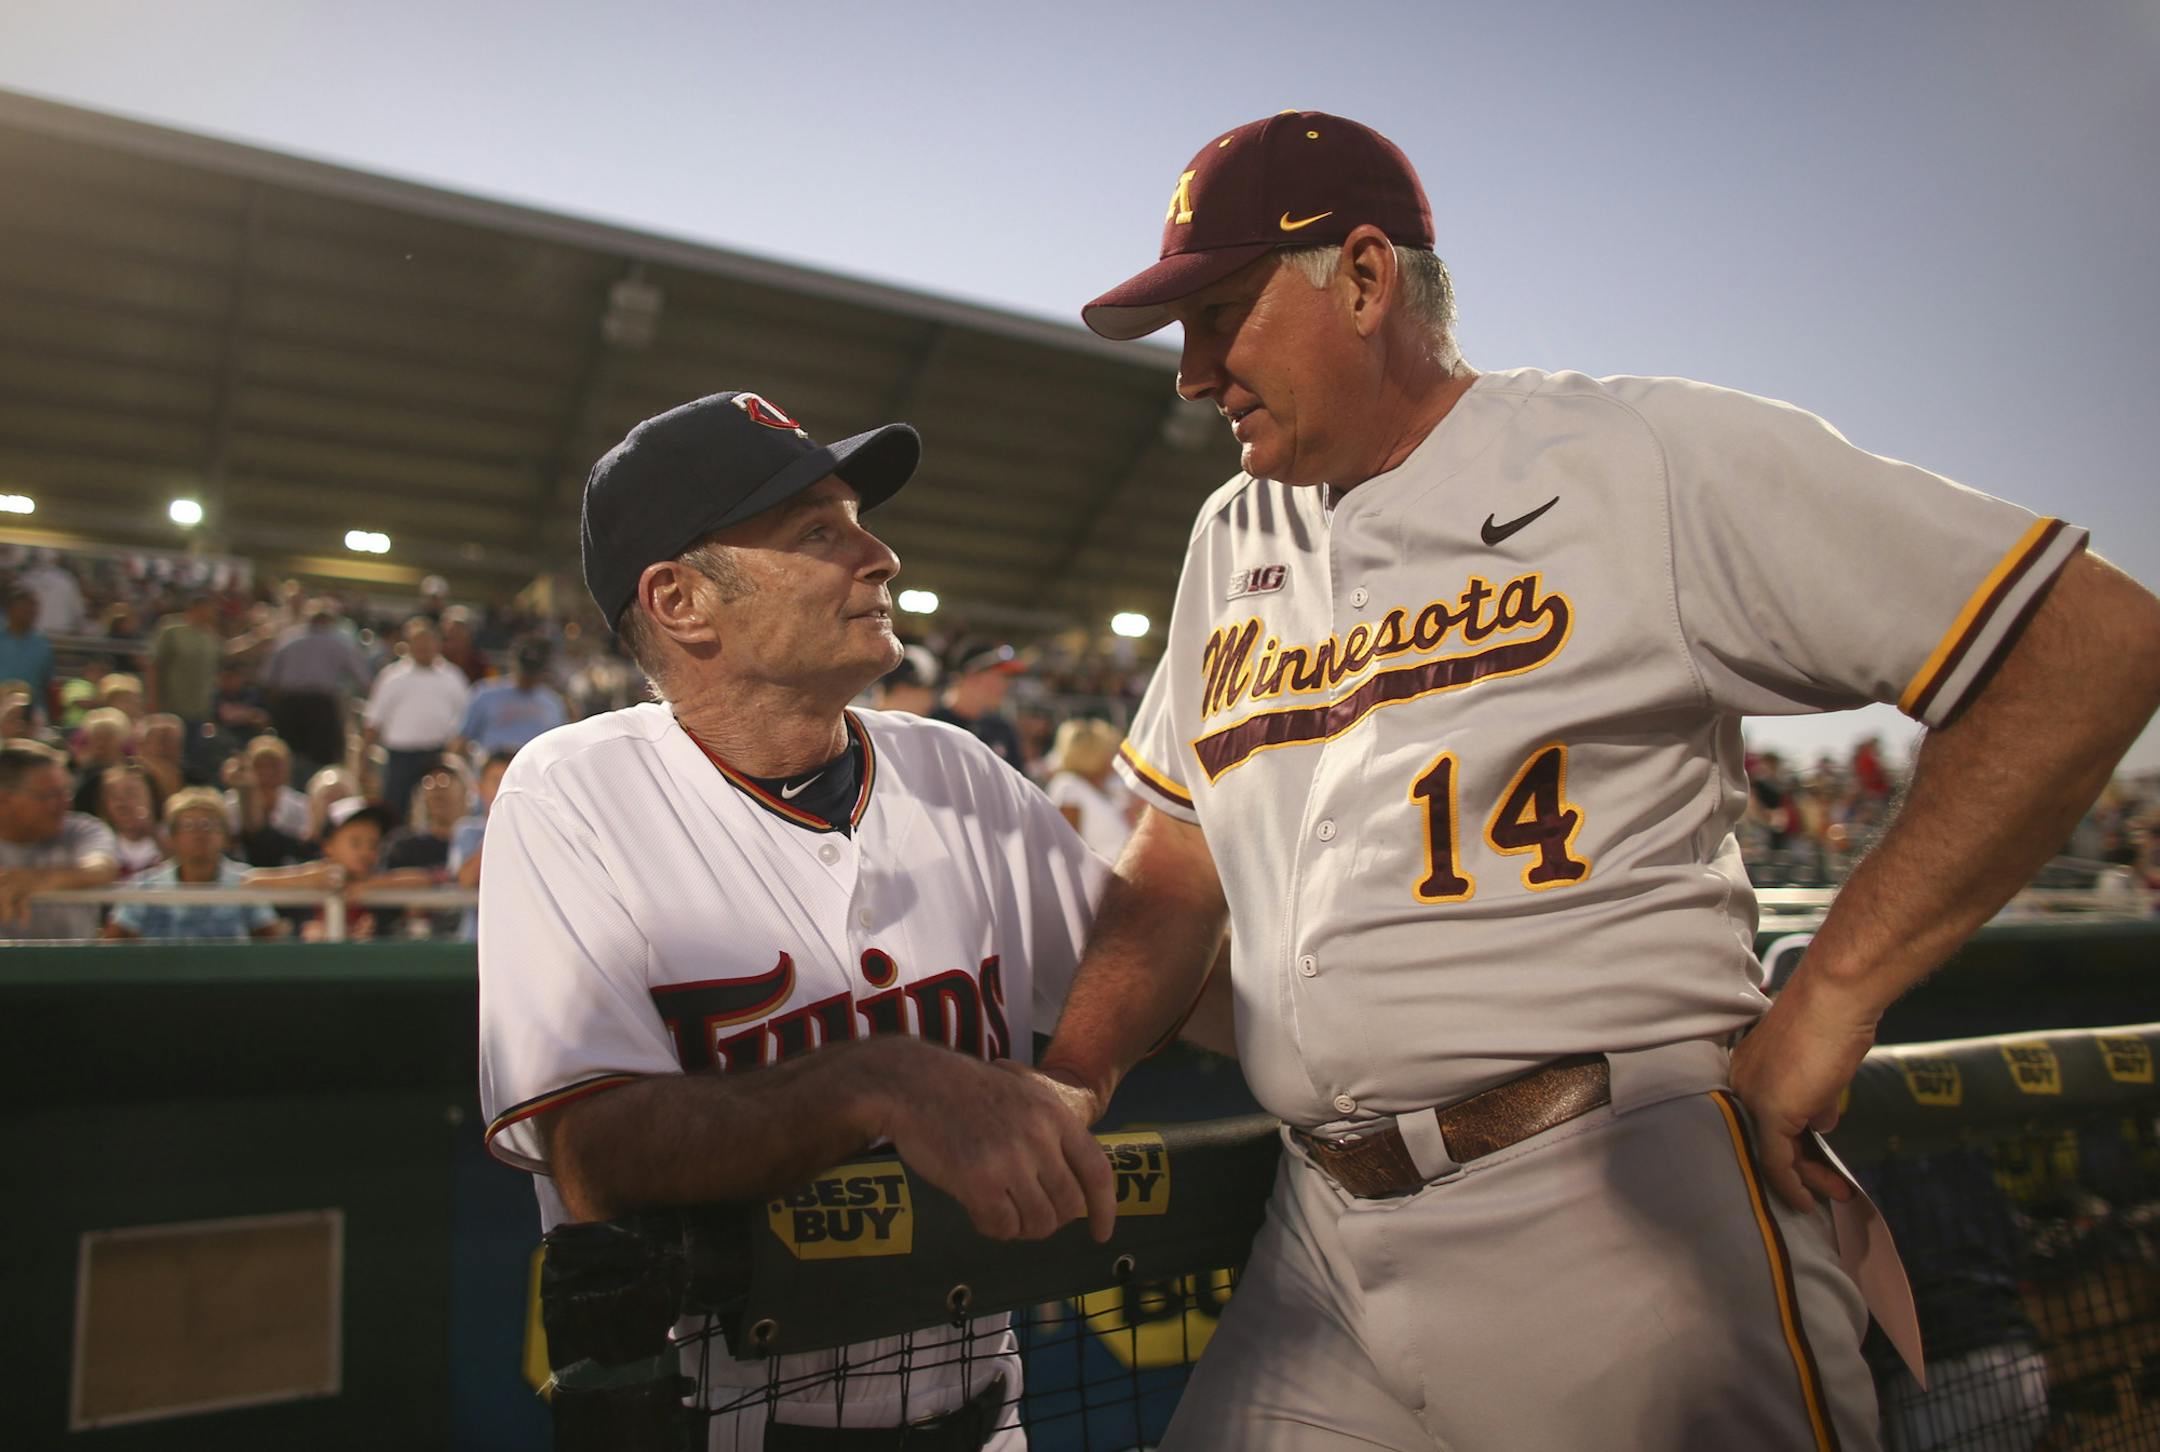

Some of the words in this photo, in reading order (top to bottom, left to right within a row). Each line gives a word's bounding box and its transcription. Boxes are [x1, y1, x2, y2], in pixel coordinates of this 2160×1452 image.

[1200, 571, 1575, 722] Minnesota
[1409, 741, 1593, 904] 14
[793, 1207, 898, 1244] BUY
